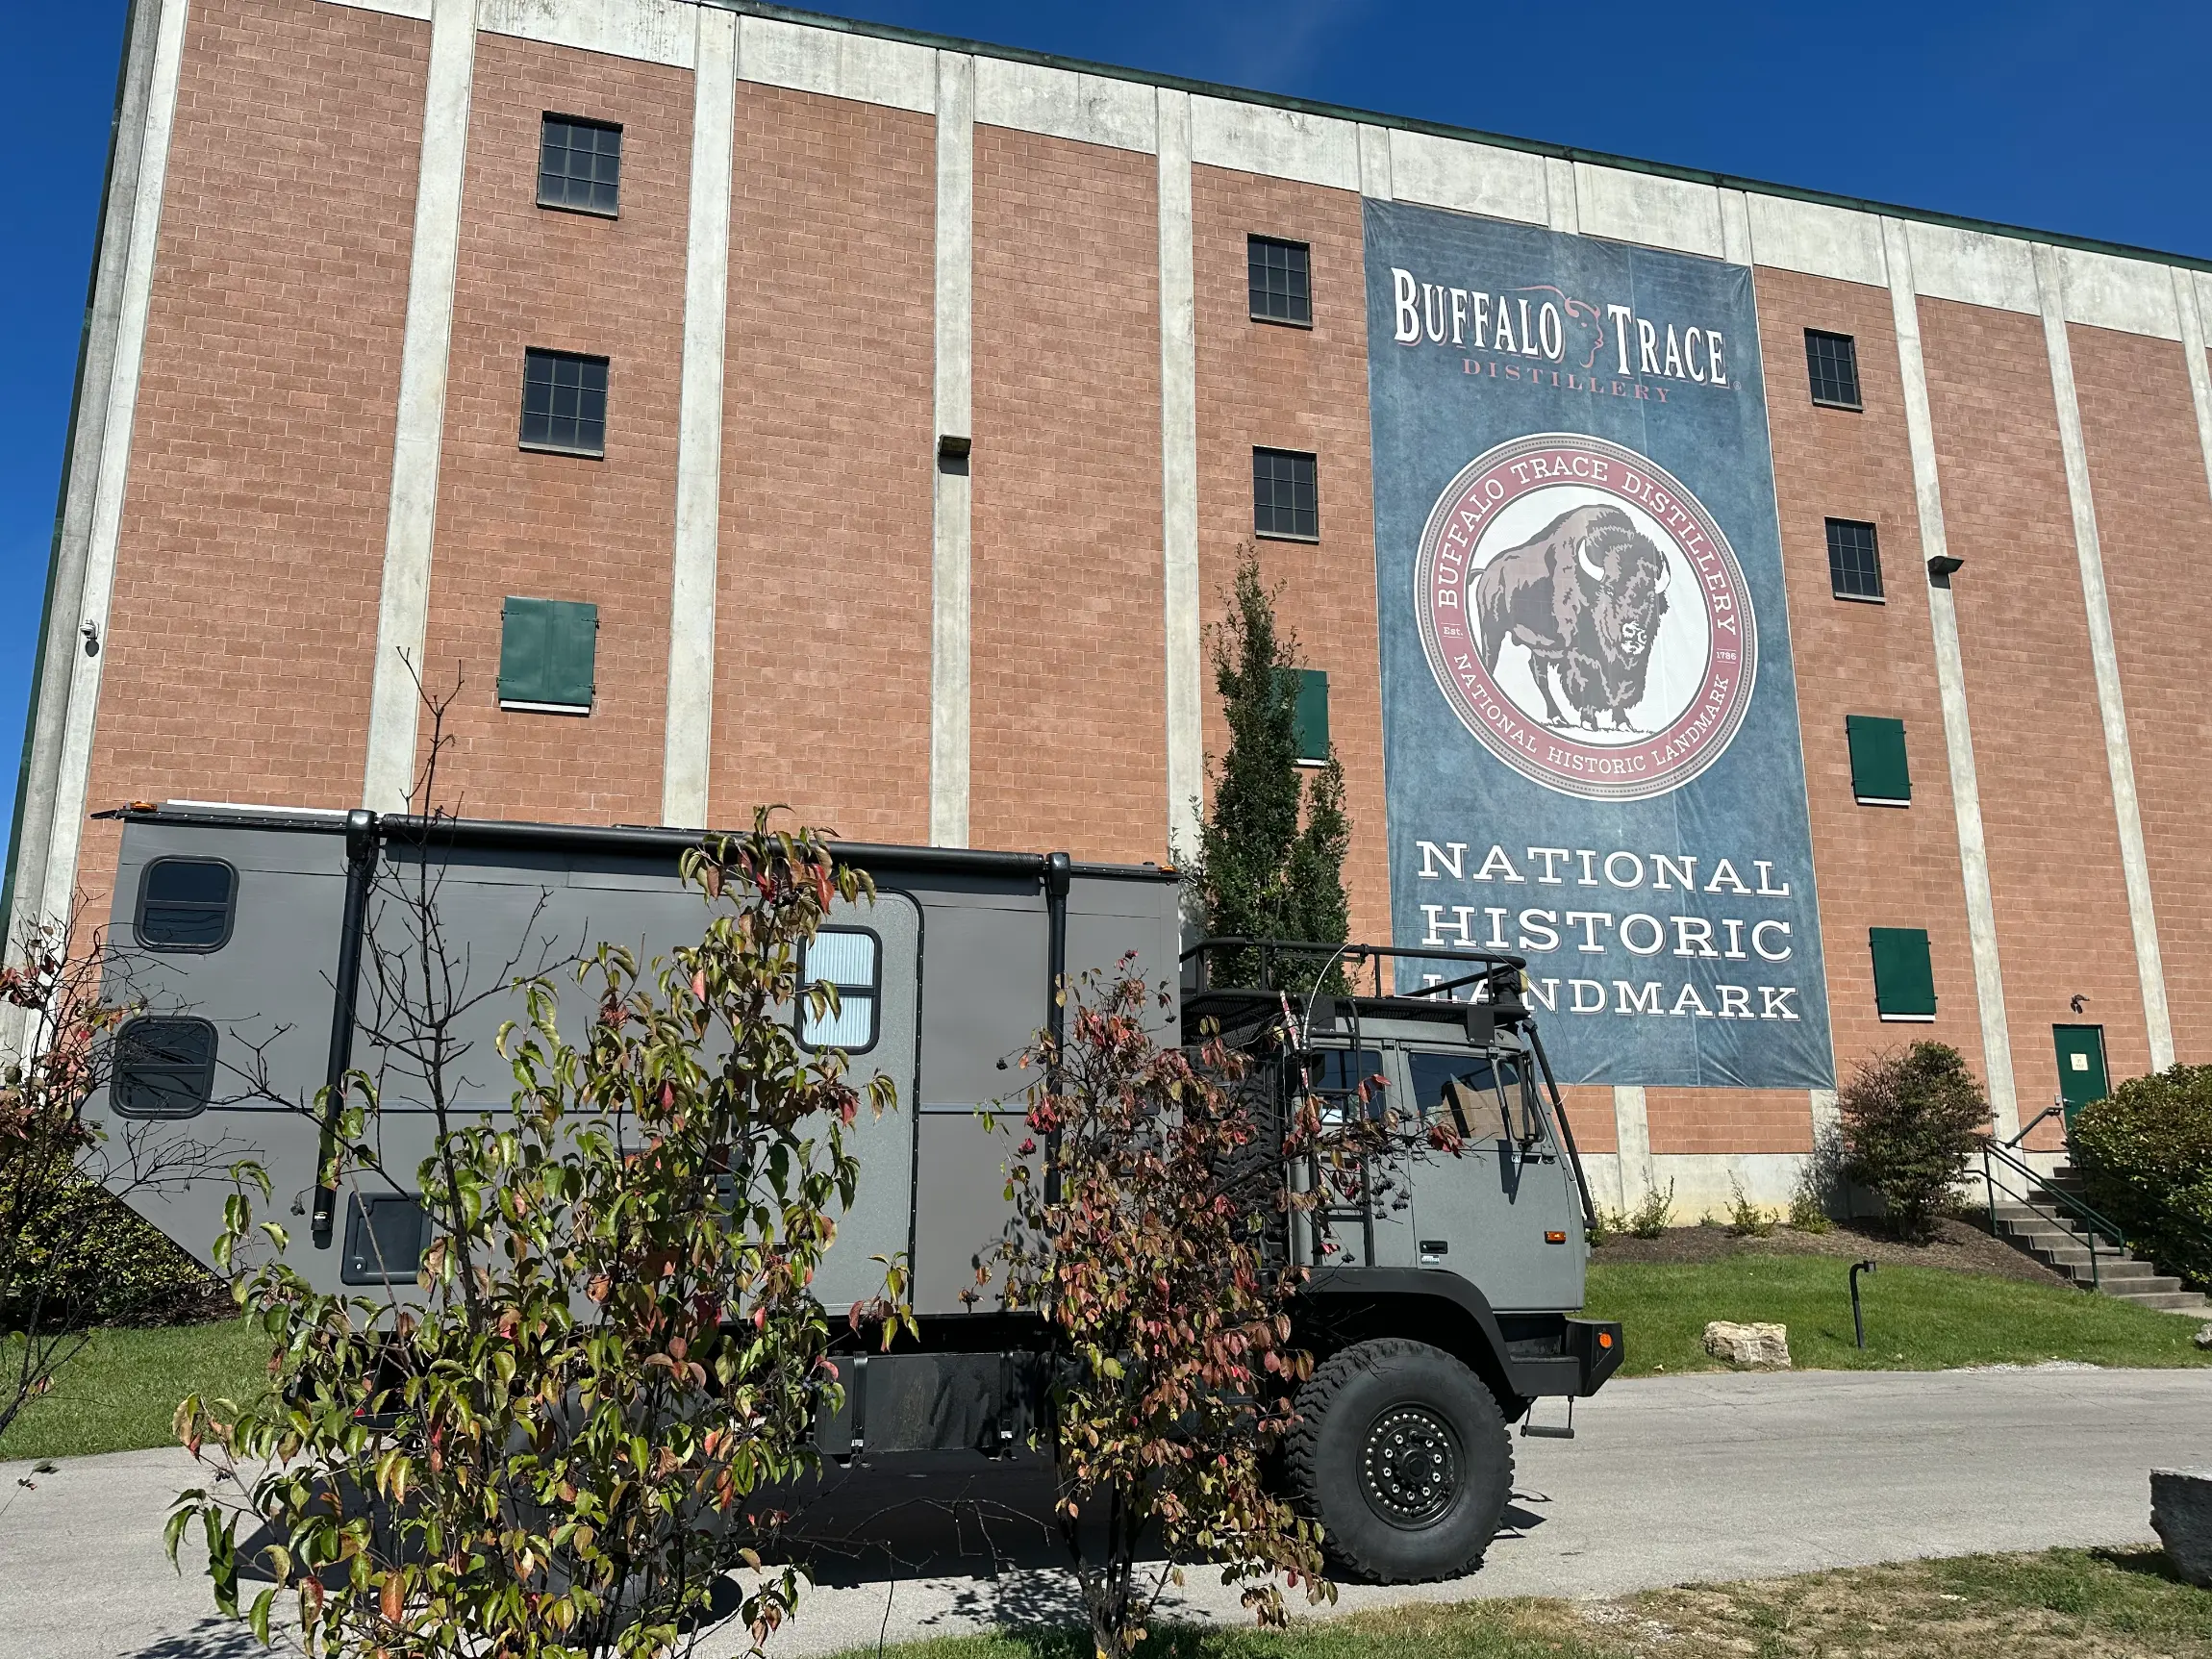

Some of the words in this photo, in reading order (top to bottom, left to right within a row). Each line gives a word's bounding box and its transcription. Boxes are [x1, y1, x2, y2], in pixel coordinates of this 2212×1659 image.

[1392, 267, 1564, 362] BUFFALO
[1607, 304, 1728, 387] TRACE
[1463, 358, 1672, 404] DISTILLERY
[1438, 478, 1505, 609] BUFFALO
[1510, 456, 1610, 486] TRACE
[1621, 471, 1737, 636] DISTILLERY
[1443, 626, 1464, 636] Est.
[1716, 651, 1737, 661] 1786
[1453, 652, 1538, 754] NATIONAL
[1546, 745, 1646, 775] HISTORIC
[1651, 673, 1729, 767] LANDMARK
[1416, 840, 1791, 897] NATIONAL
[1420, 904, 1793, 962] HISTORIC
